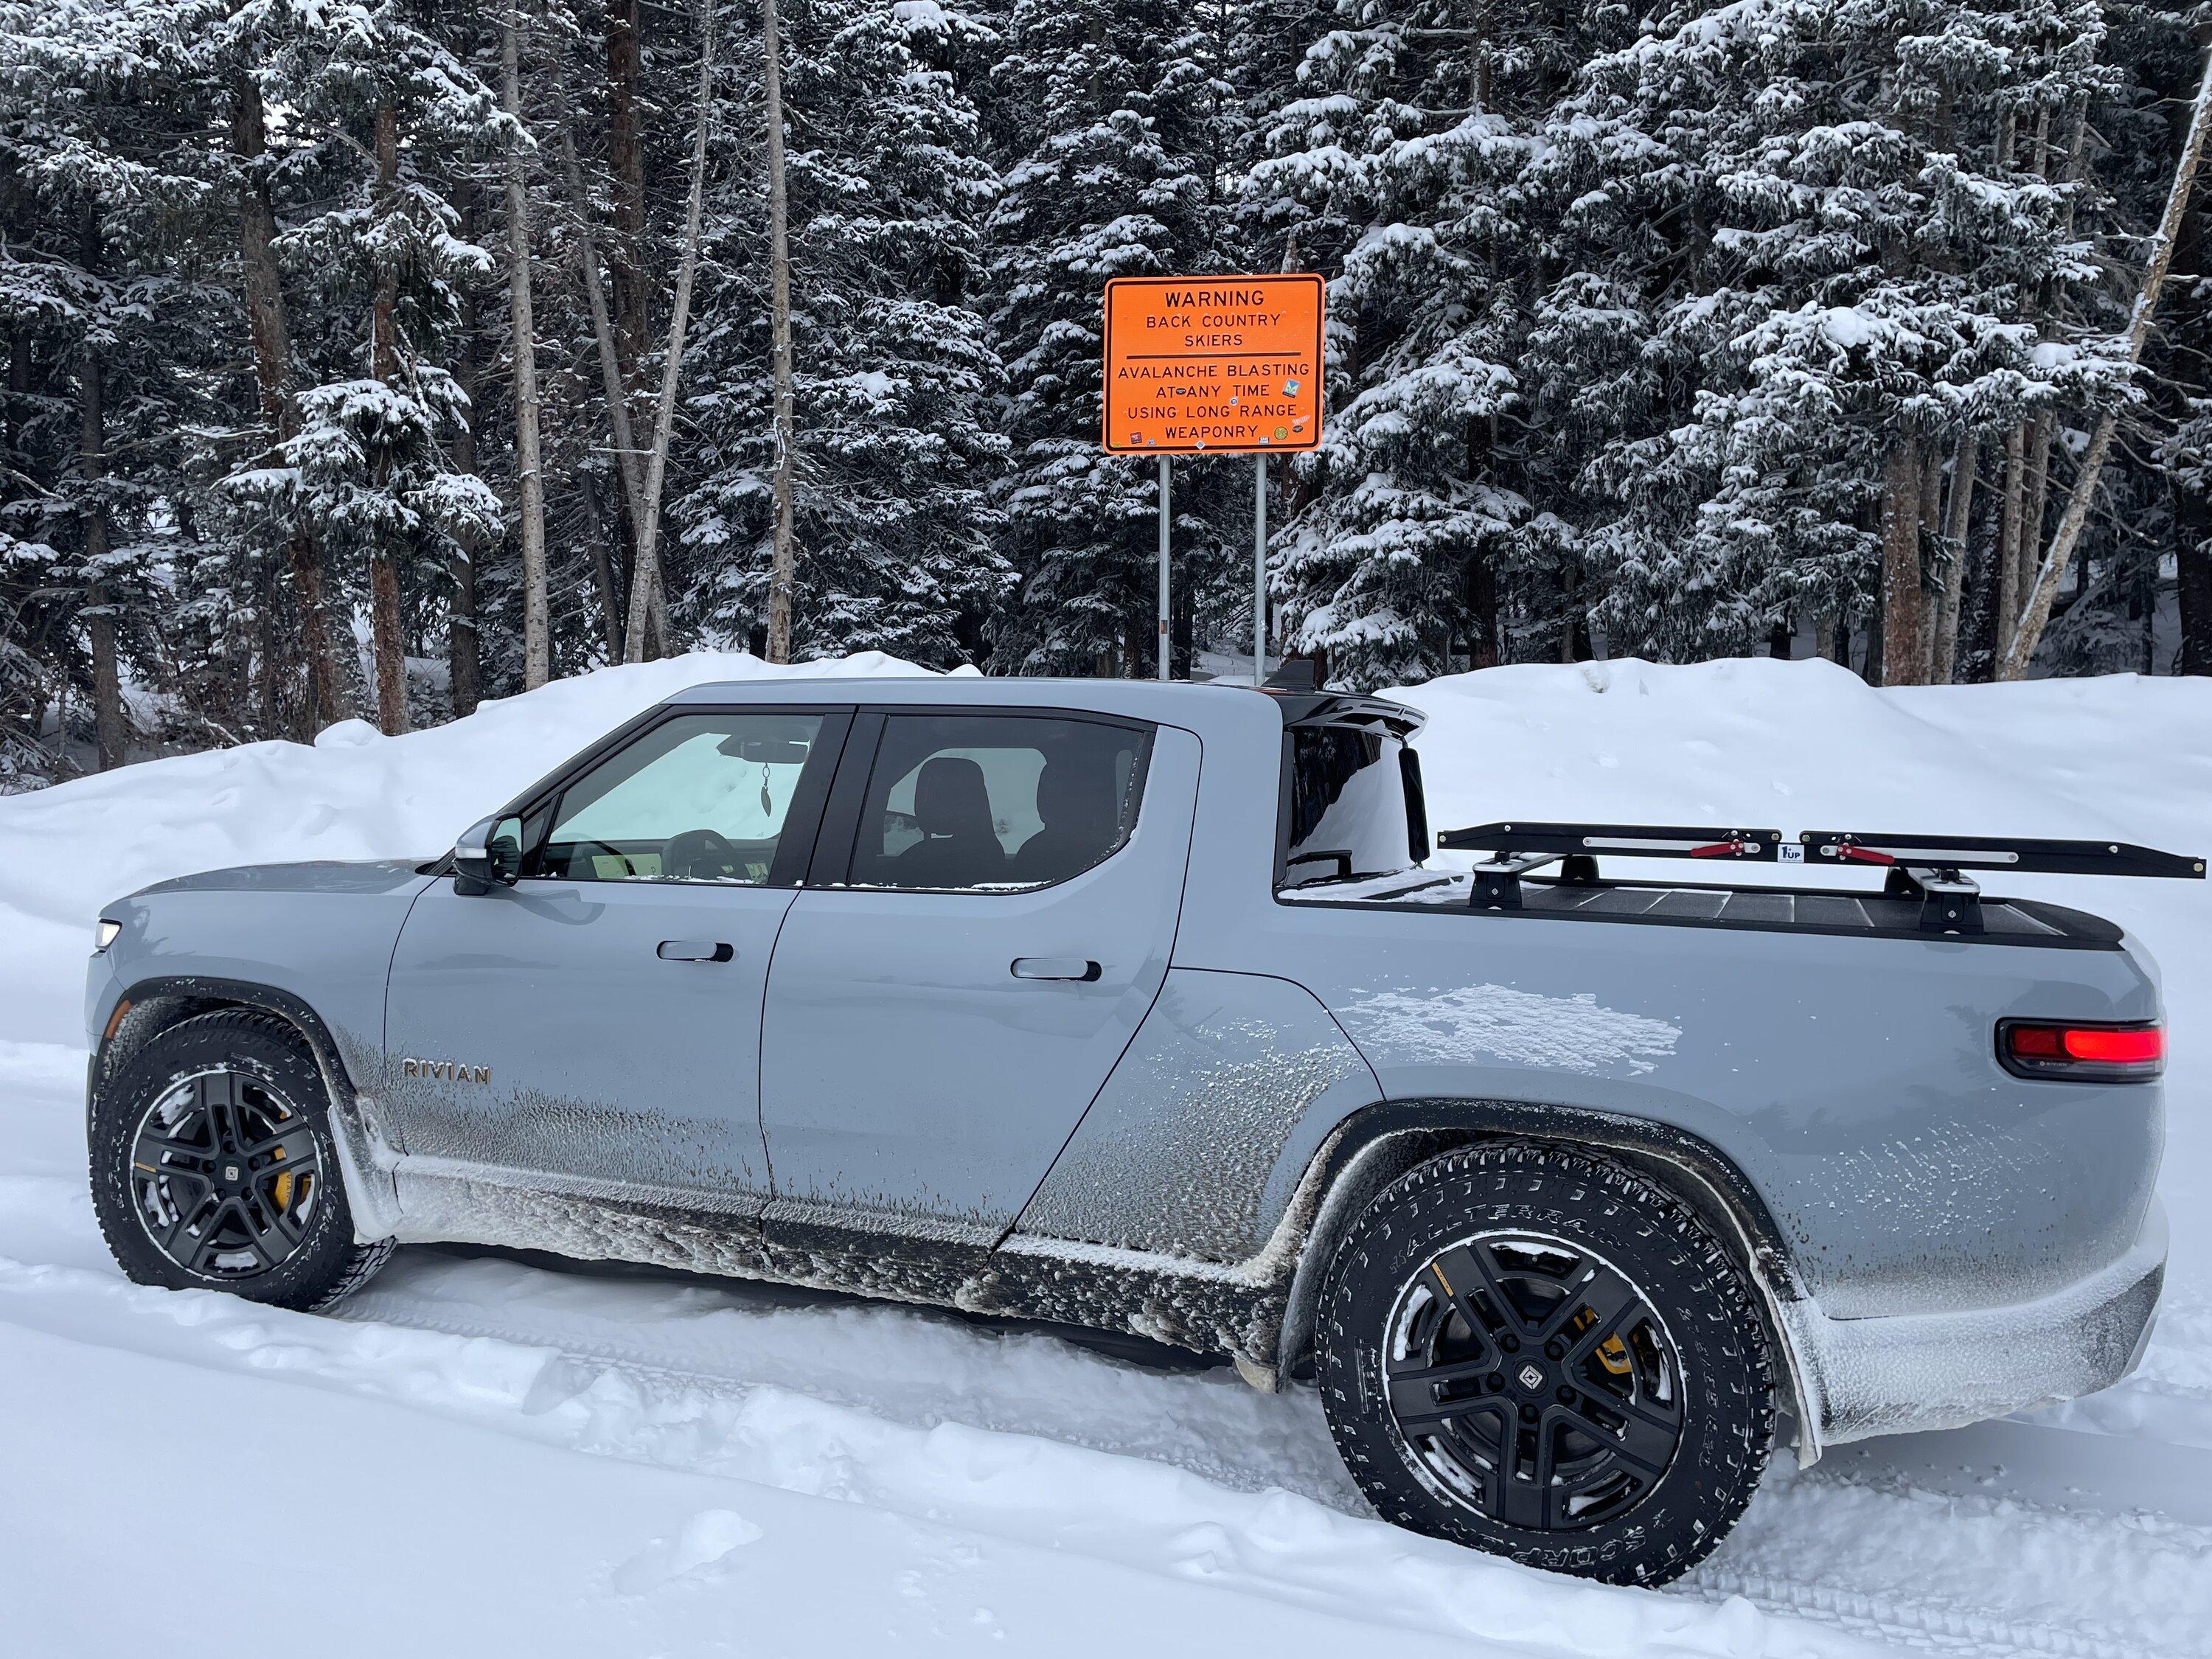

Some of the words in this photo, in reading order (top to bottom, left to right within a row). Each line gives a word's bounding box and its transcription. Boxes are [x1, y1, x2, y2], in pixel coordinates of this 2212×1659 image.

[1165, 291, 1264, 307] WARNING
[1147, 316, 1191, 328] BACK
[1202, 314, 1280, 327] COUNTRY
[1185, 334, 1242, 347] SKIERS
[1118, 366, 1217, 378] AVALANCHE
[1227, 364, 1309, 376] BLASTING
[1156, 386, 1175, 398] AT
[1186, 386, 1221, 397] ANY
[1233, 384, 1270, 396] TIME
[1128, 407, 1176, 419] USING
[1186, 406, 1230, 418] LONG
[1240, 404, 1296, 417] RANGE
[1165, 425, 1259, 439] WEAPONRY
[403, 1058, 491, 1085] RIVIAN
